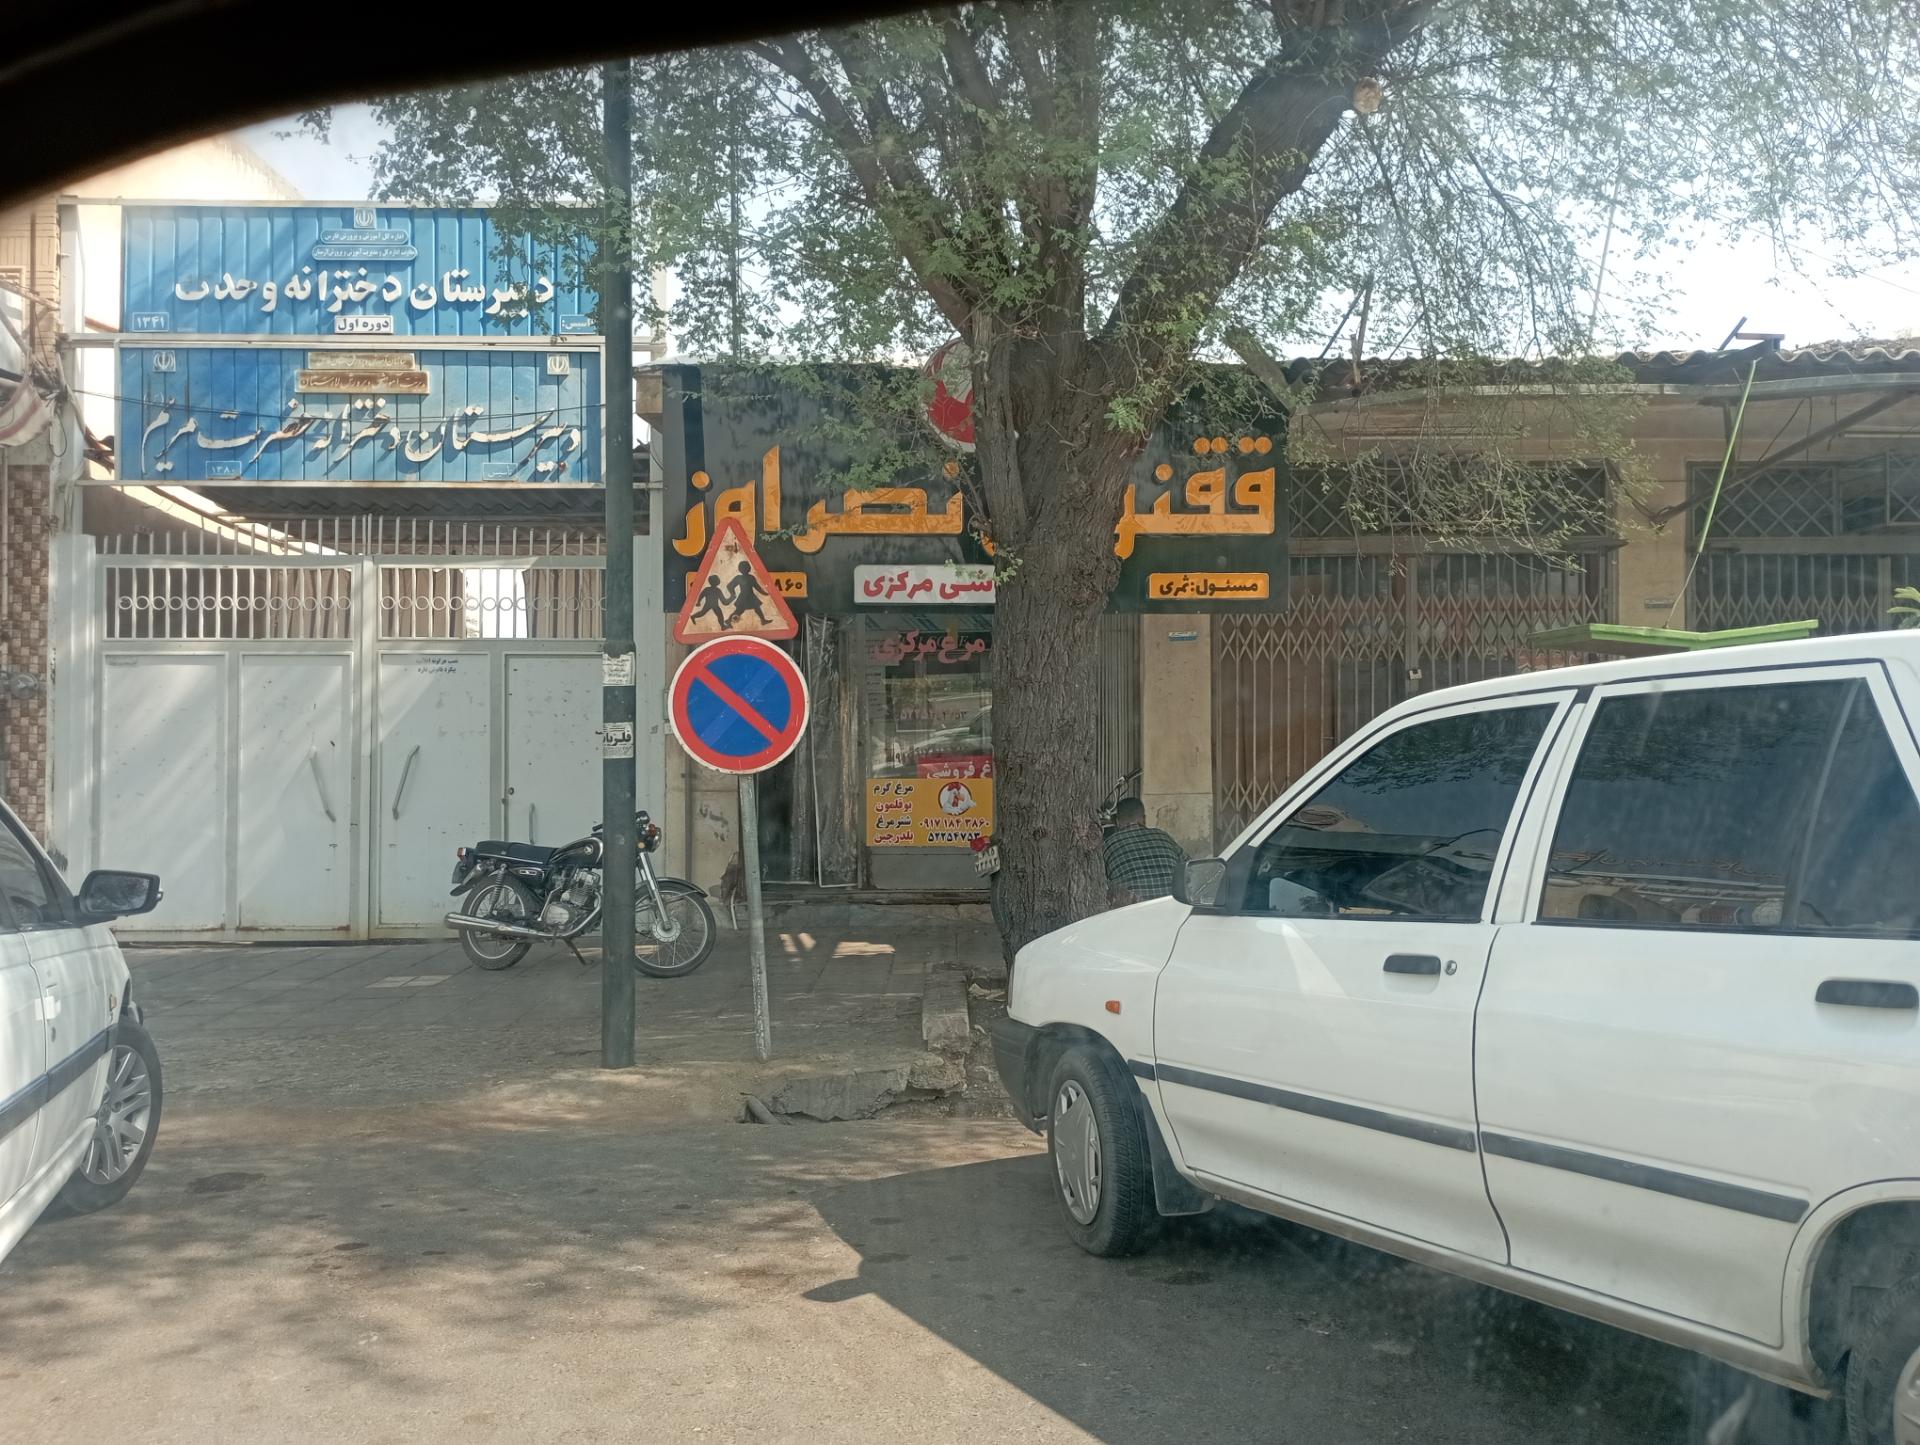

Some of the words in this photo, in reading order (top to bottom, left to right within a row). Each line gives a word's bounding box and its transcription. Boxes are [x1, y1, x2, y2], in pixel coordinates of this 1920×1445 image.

[285, 265, 402, 313] دخترانه
[410, 267, 554, 318] دبیرستان
[338, 318, 359, 331] اول
[361, 319, 390, 332] دوره
[196, 397, 317, 465] حضرت
[404, 406, 582, 473] دبیرستان
[672, 444, 781, 557] اوز
[792, 458, 965, 554] نصر
[863, 571, 934, 599] مرکزی
[873, 782, 892, 796] گرم
[894, 783, 914, 796] مرغ
[875, 798, 913, 813] بوقلمون
[874, 830, 914, 844] بلدرچین
